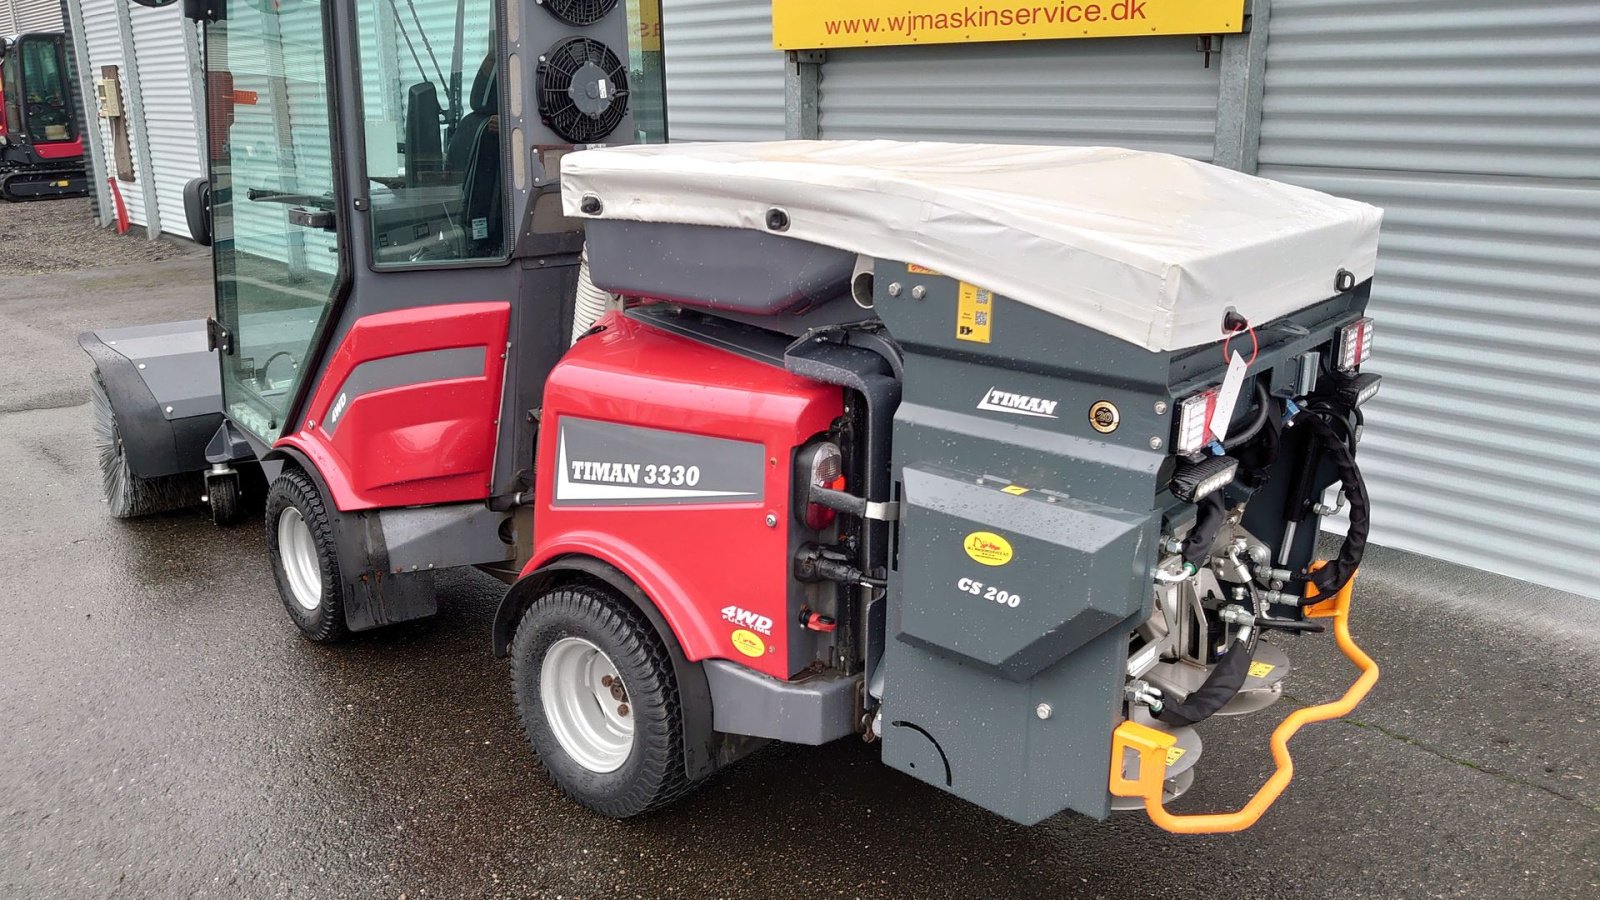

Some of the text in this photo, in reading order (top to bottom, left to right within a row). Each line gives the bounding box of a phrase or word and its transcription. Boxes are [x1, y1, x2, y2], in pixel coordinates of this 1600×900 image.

[825, 0, 1147, 36] www.wjmaskinservice.dk
[331, 392, 347, 424] 4WD
[990, 391, 1058, 415] TIMAN
[572, 461, 700, 486] TIMAN 3330
[957, 577, 1021, 608] CS 200
[721, 605, 773, 629] 4WD
